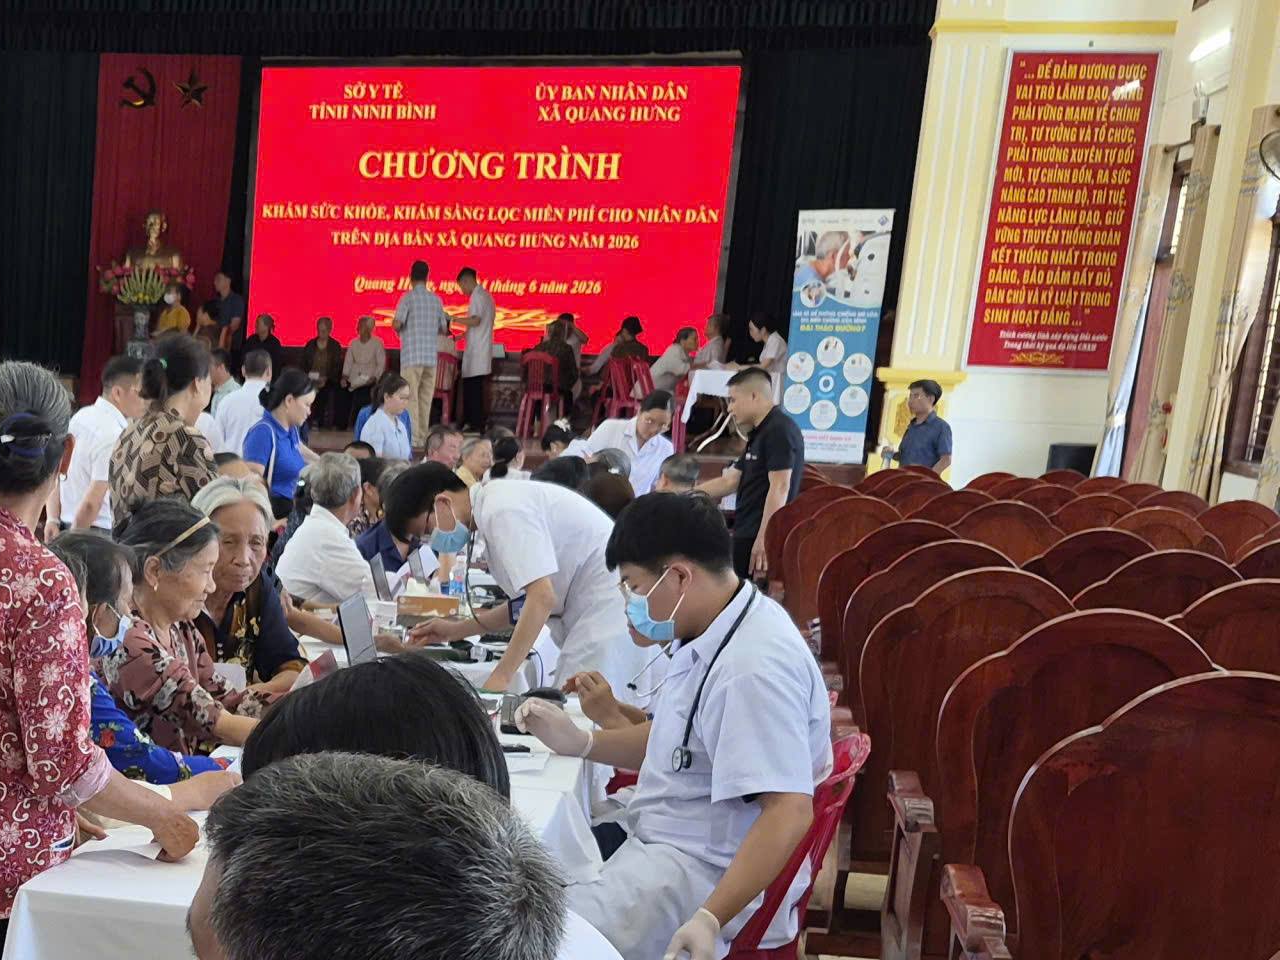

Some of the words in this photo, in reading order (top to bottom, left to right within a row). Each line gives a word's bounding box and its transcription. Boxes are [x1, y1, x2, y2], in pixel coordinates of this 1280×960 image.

[344, 81, 366, 100] SỞ
[368, 84, 380, 100] Y
[383, 80, 404, 100] TẾ
[535, 81, 559, 101] ỦY
[561, 84, 596, 101] BAN
[600, 81, 648, 101] NHÂN
[651, 81, 688, 101] DÂN
[1016, 85, 1033, 100] VAI
[1035, 81, 1054, 100] TRÒ
[352, 104, 393, 120] NINH
[396, 101, 437, 120] BÌNH
[538, 103, 560, 122] XÃ
[565, 106, 626, 124] QUANG
[629, 104, 681, 122] HƯNG
[1012, 102, 1035, 120] PHẢI
[1037, 104, 1063, 121] VỮNG
[1064, 106, 1093, 124] MẠNH
[1110, 104, 1140, 122] CHÍNH
[1031, 127, 1044, 141] TƯ
[1079, 125, 1091, 142] VÀ
[358, 146, 505, 180] CHƯƠNG
[513, 145, 622, 180] TRÌNH
[1007, 141, 1029, 161] PHẢI
[1032, 145, 1069, 162] THƯỜNG
[1071, 145, 1102, 163] XUYÊN
[1104, 148, 1117, 166] TỰ
[1027, 168, 1041, 186] TỰ
[1041, 164, 1070, 183] CHỈNH
[1096, 169, 1109, 184] RA
[1111, 167, 1131, 184] SỨC
[1000, 185, 1026, 203] NÂNG
[1027, 188, 1045, 203] CAO
[1047, 187, 1074, 204] TRÌNH
[1092, 187, 1106, 204] TRÍ
[261, 202, 308, 219] KHÁM
[310, 201, 341, 219] SỨC
[394, 203, 441, 220] KHÁM
[487, 207, 520, 224] LỌC
[567, 205, 596, 222] PHÍ
[597, 208, 633, 223] CHO
[636, 205, 682, 223] NHÂN
[684, 205, 719, 224] DÂN
[997, 206, 1026, 223] NĂNG
[1028, 208, 1048, 226] LỰC
[1105, 206, 1125, 224] GIỮ
[331, 228, 370, 246] TRÊN
[374, 231, 400, 248] ĐỊA
[403, 229, 434, 246] BÀN
[437, 229, 458, 247] XÃ
[461, 233, 516, 249] QUANG
[519, 233, 565, 249] HƯNG
[567, 232, 604, 248] NĂM
[607, 235, 639, 249] 2026
[994, 226, 1021, 243] VỮNG
[1061, 226, 1092, 244] THỐNG
[991, 245, 1011, 263] KẾT
[1013, 245, 1048, 264] THỐNG
[1081, 250, 1117, 266] TRONG
[1023, 266, 1044, 284] BẢO
[354, 276, 395, 293] Quang
[490, 279, 526, 295] tháng
[528, 280, 536, 293] 6
[539, 280, 568, 294] năm
[570, 281, 601, 294] 2026
[1007, 285, 1025, 303] CHỦ
[1027, 287, 1039, 304] VÀ
[1055, 288, 1078, 308] LUẬT
[1080, 291, 1111, 306] TRONG
[983, 309, 1009, 323] SINH
[1011, 310, 1039, 326] HOẠT
